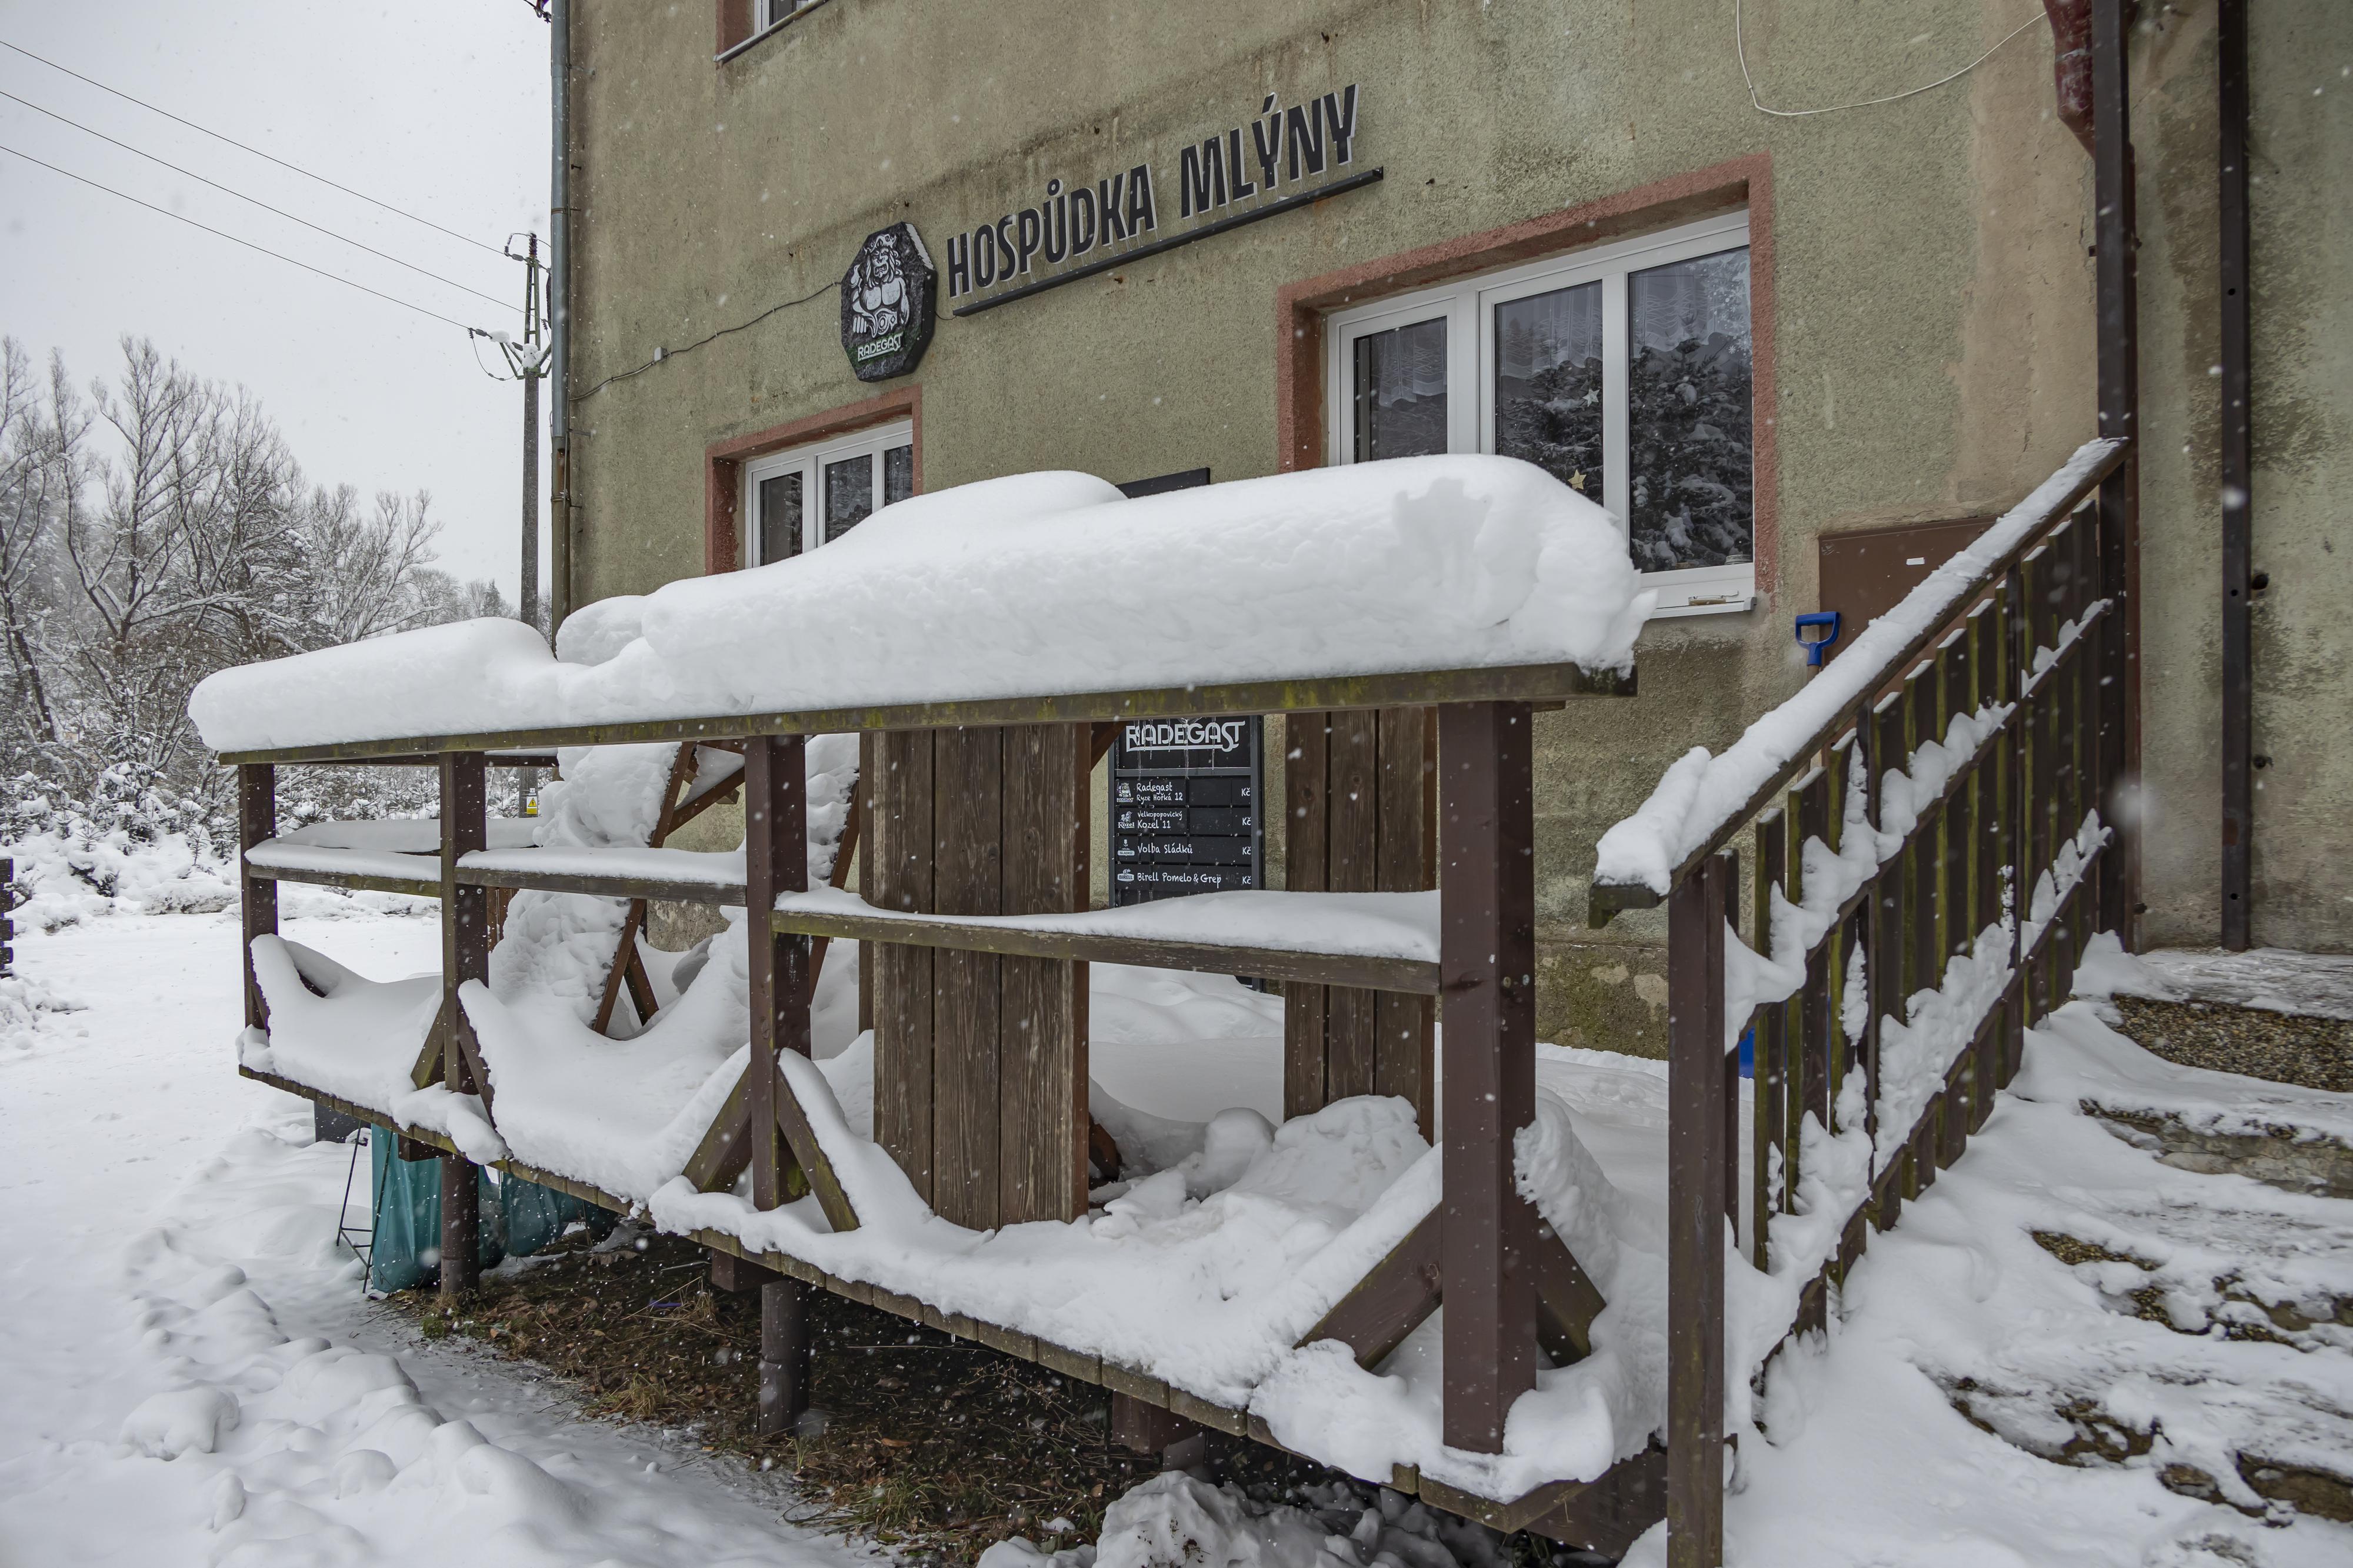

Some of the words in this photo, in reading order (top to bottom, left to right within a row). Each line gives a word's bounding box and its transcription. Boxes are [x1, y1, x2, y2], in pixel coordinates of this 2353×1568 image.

[946, 164, 1158, 299] HOSPŮDKA
[1180, 83, 1360, 219] MLÝNY
[858, 331, 904, 362] RADEGAST
[1125, 720, 1246, 752] RADEGAST
[1136, 781, 1173, 795] Radegast
[1241, 788, 1251, 797] Kč
[1136, 794, 1151, 805] Ryze
[1153, 792, 1172, 801] Hořká
[1175, 792, 1183, 801] 12
[1137, 810, 1182, 821] Velkopopovický
[1242, 816, 1251, 826] Kč
[1138, 819, 1159, 829] Kozel
[1162, 820, 1171, 829] 11
[1137, 842, 1161, 854] Volba
[1164, 842, 1194, 854] Sládků
[1242, 846, 1251, 855] Kč
[1137, 872, 1159, 882] Birell
[1162, 872, 1192, 883] Pomelo
[1193, 873, 1199, 883] &
[1200, 873, 1222, 889] Grep
[1242, 875, 1251, 885] Kč
